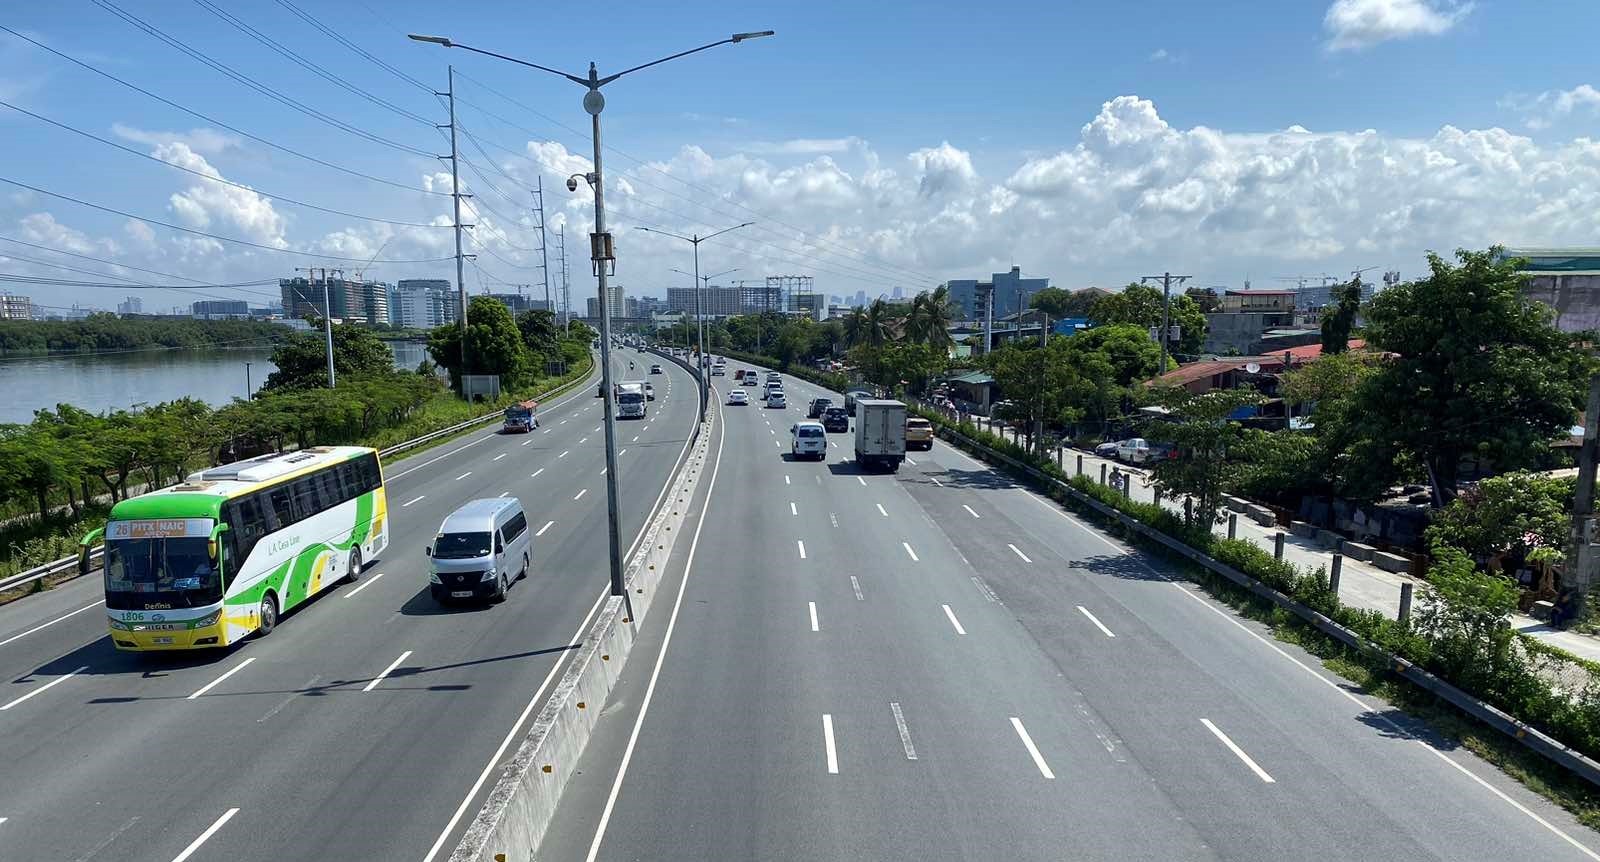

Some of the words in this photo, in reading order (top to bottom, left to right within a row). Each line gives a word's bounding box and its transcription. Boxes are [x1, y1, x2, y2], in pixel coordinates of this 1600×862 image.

[131, 522, 155, 531] PITX
[159, 521, 184, 531] NAIC
[121, 612, 144, 621] 1806
